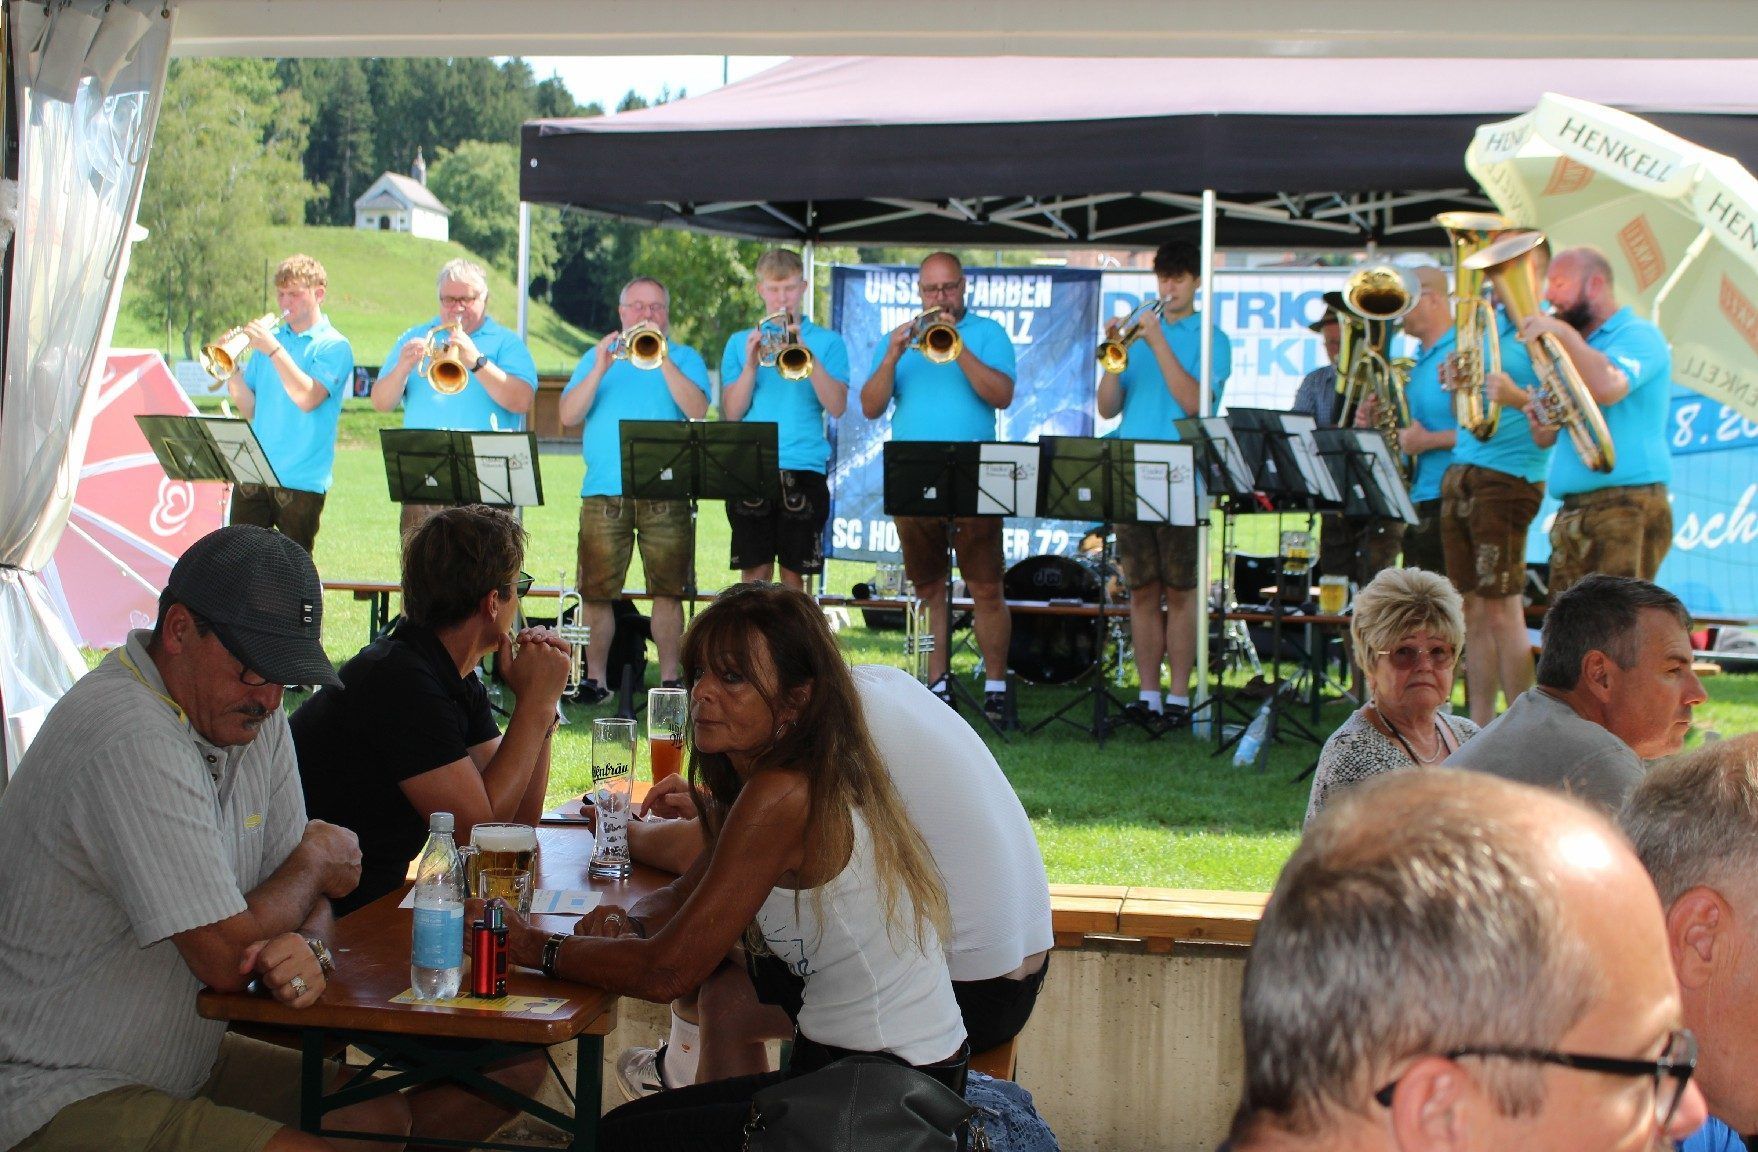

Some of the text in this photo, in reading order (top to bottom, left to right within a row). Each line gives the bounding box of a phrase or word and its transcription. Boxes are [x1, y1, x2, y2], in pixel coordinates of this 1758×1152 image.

[1559, 117, 1672, 183] HENKELL
[832, 517, 863, 551] SC
[1035, 529, 1069, 557] 72
